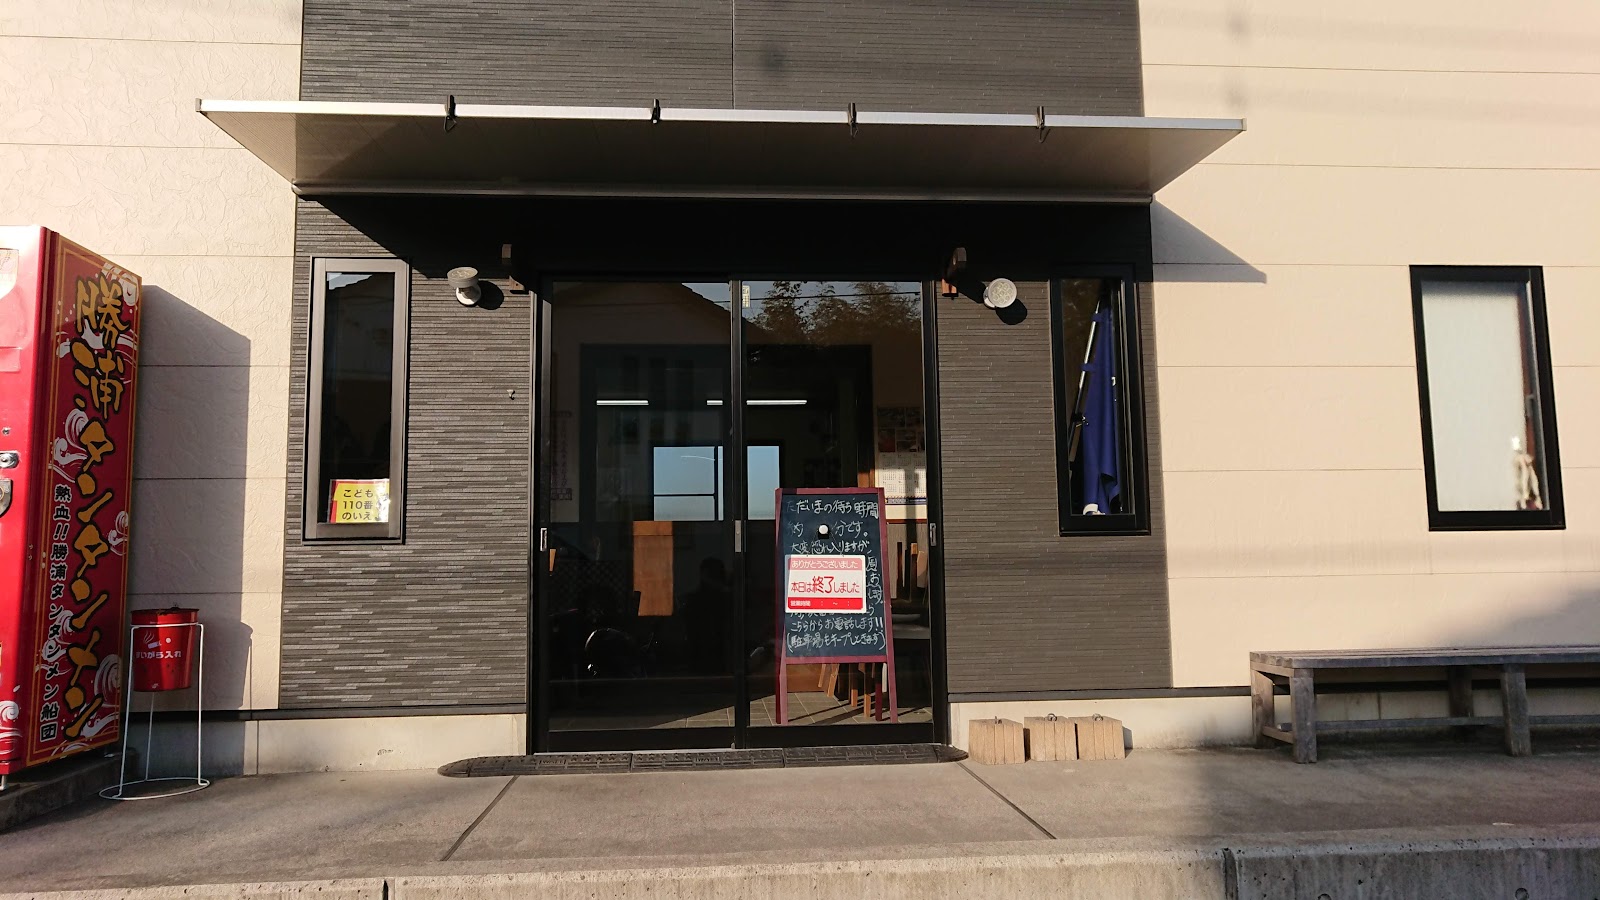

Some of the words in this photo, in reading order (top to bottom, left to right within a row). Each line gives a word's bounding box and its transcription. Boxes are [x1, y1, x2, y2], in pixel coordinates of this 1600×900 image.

[343, 489, 374, 498] こども
[65, 275, 130, 738] 勝浦タンタンメン
[343, 500, 373, 510] 110番
[341, 511, 372, 521] のいえ
[791, 560, 858, 569] ありがとうございました
[791, 575, 860, 594] 本日は終了しました
[136, 650, 181, 659] すいがら入れ
